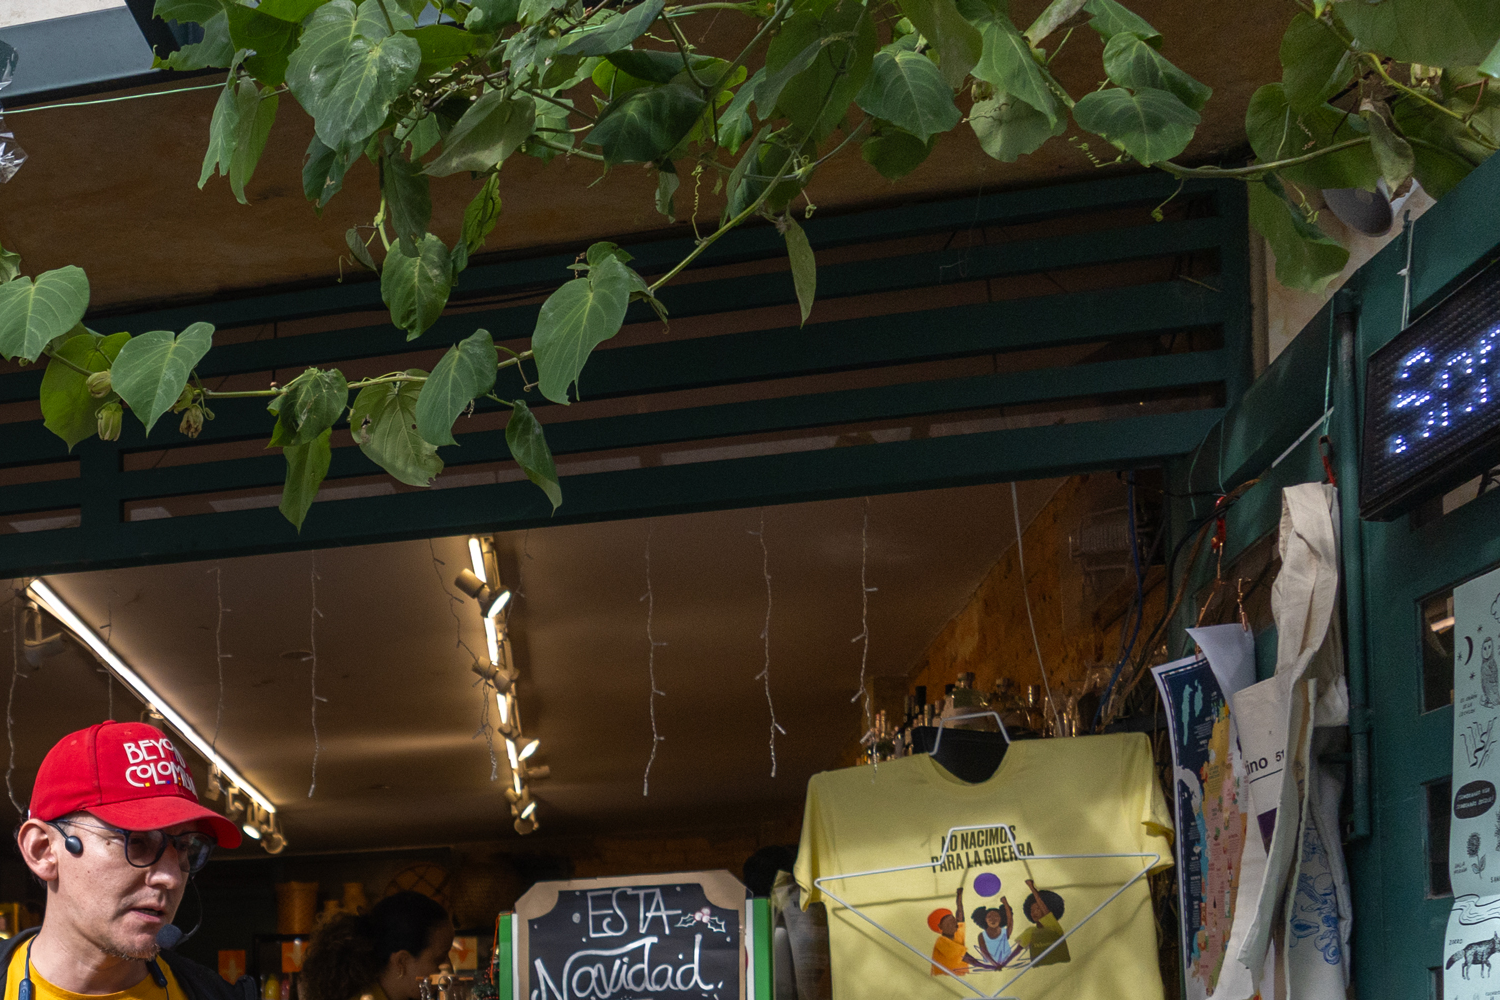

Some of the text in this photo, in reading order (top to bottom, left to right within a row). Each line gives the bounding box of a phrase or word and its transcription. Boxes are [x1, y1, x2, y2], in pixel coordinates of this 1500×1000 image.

[123, 738, 187, 769] BEYOND
[125, 761, 198, 800] COLOMBIA
[941, 825, 1016, 854] NO NACIMOS
[931, 842, 1034, 873] PARA LA GUERRA
[587, 888, 682, 938] ESTA
